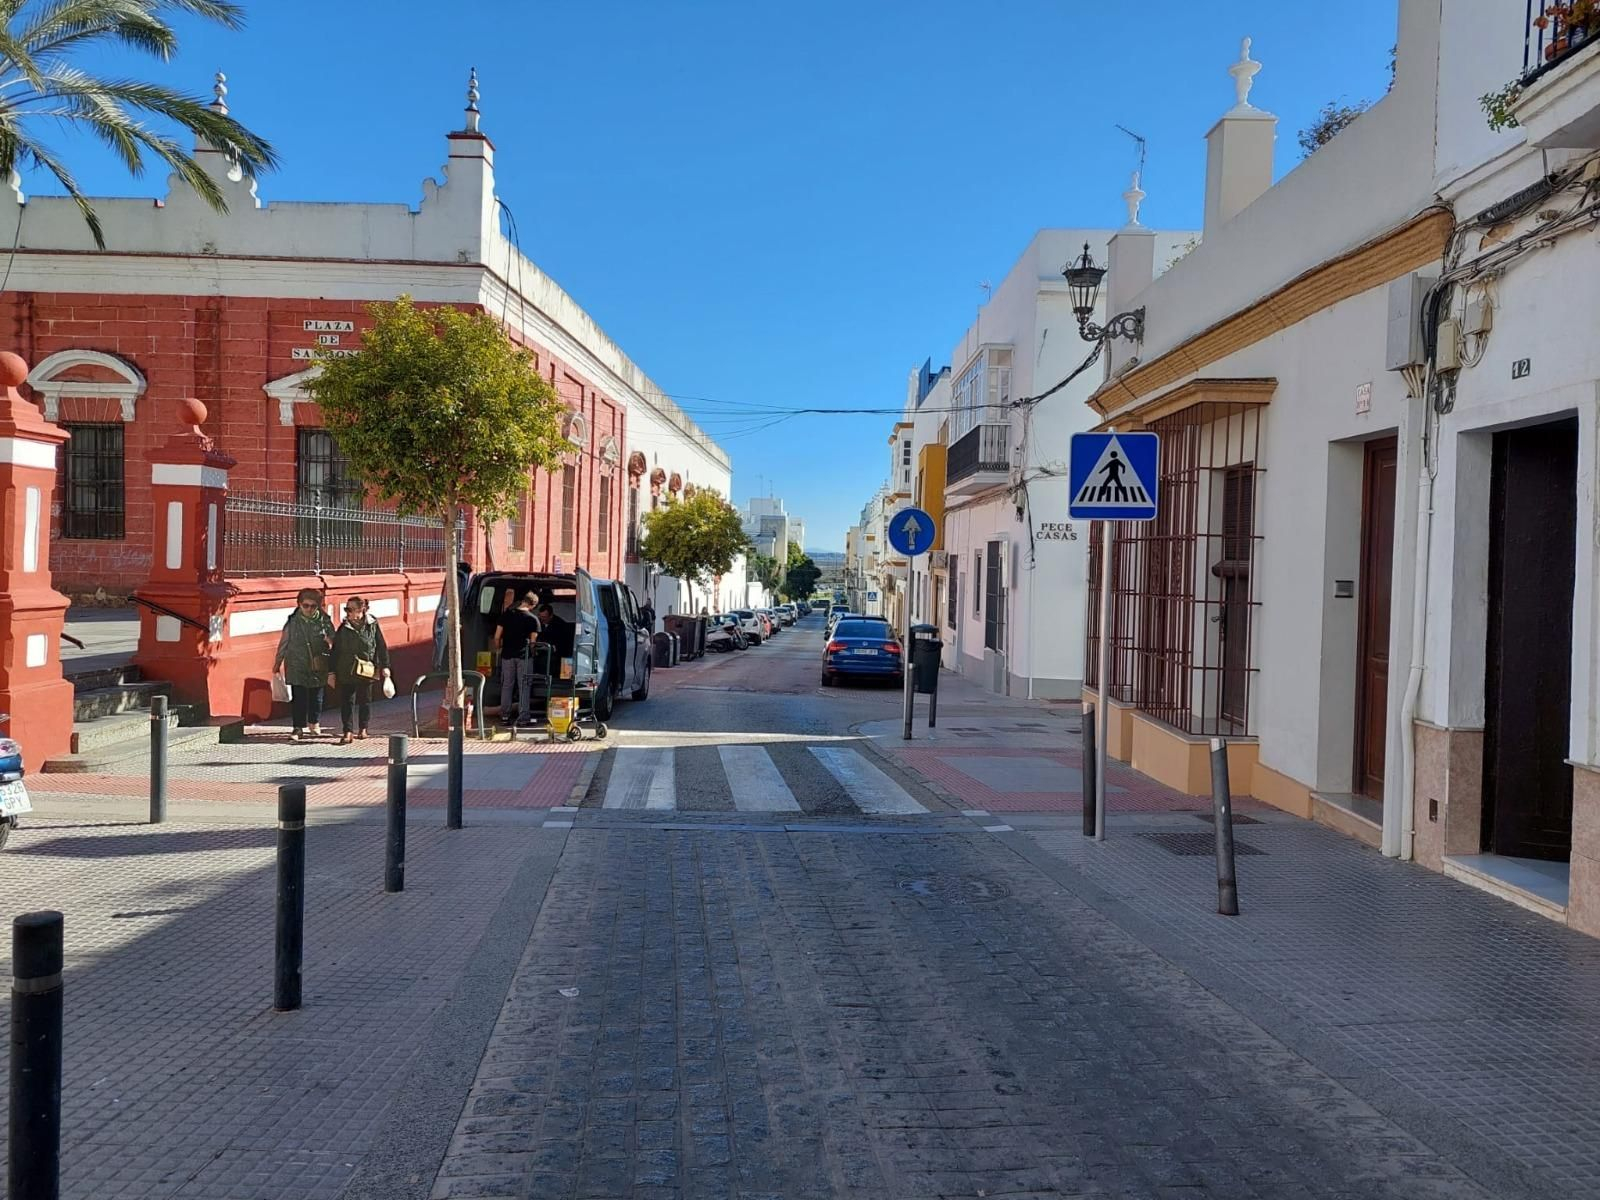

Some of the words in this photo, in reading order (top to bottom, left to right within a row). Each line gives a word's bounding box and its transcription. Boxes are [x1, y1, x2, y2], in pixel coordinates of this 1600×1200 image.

[305, 321, 352, 330] PLAZA
[320, 336, 337, 344] DE
[293, 348, 322, 358] SAN
[1513, 359, 1528, 377] 12
[1036, 532, 1077, 541] CASAS
[4, 796, 22, 809] GPY
